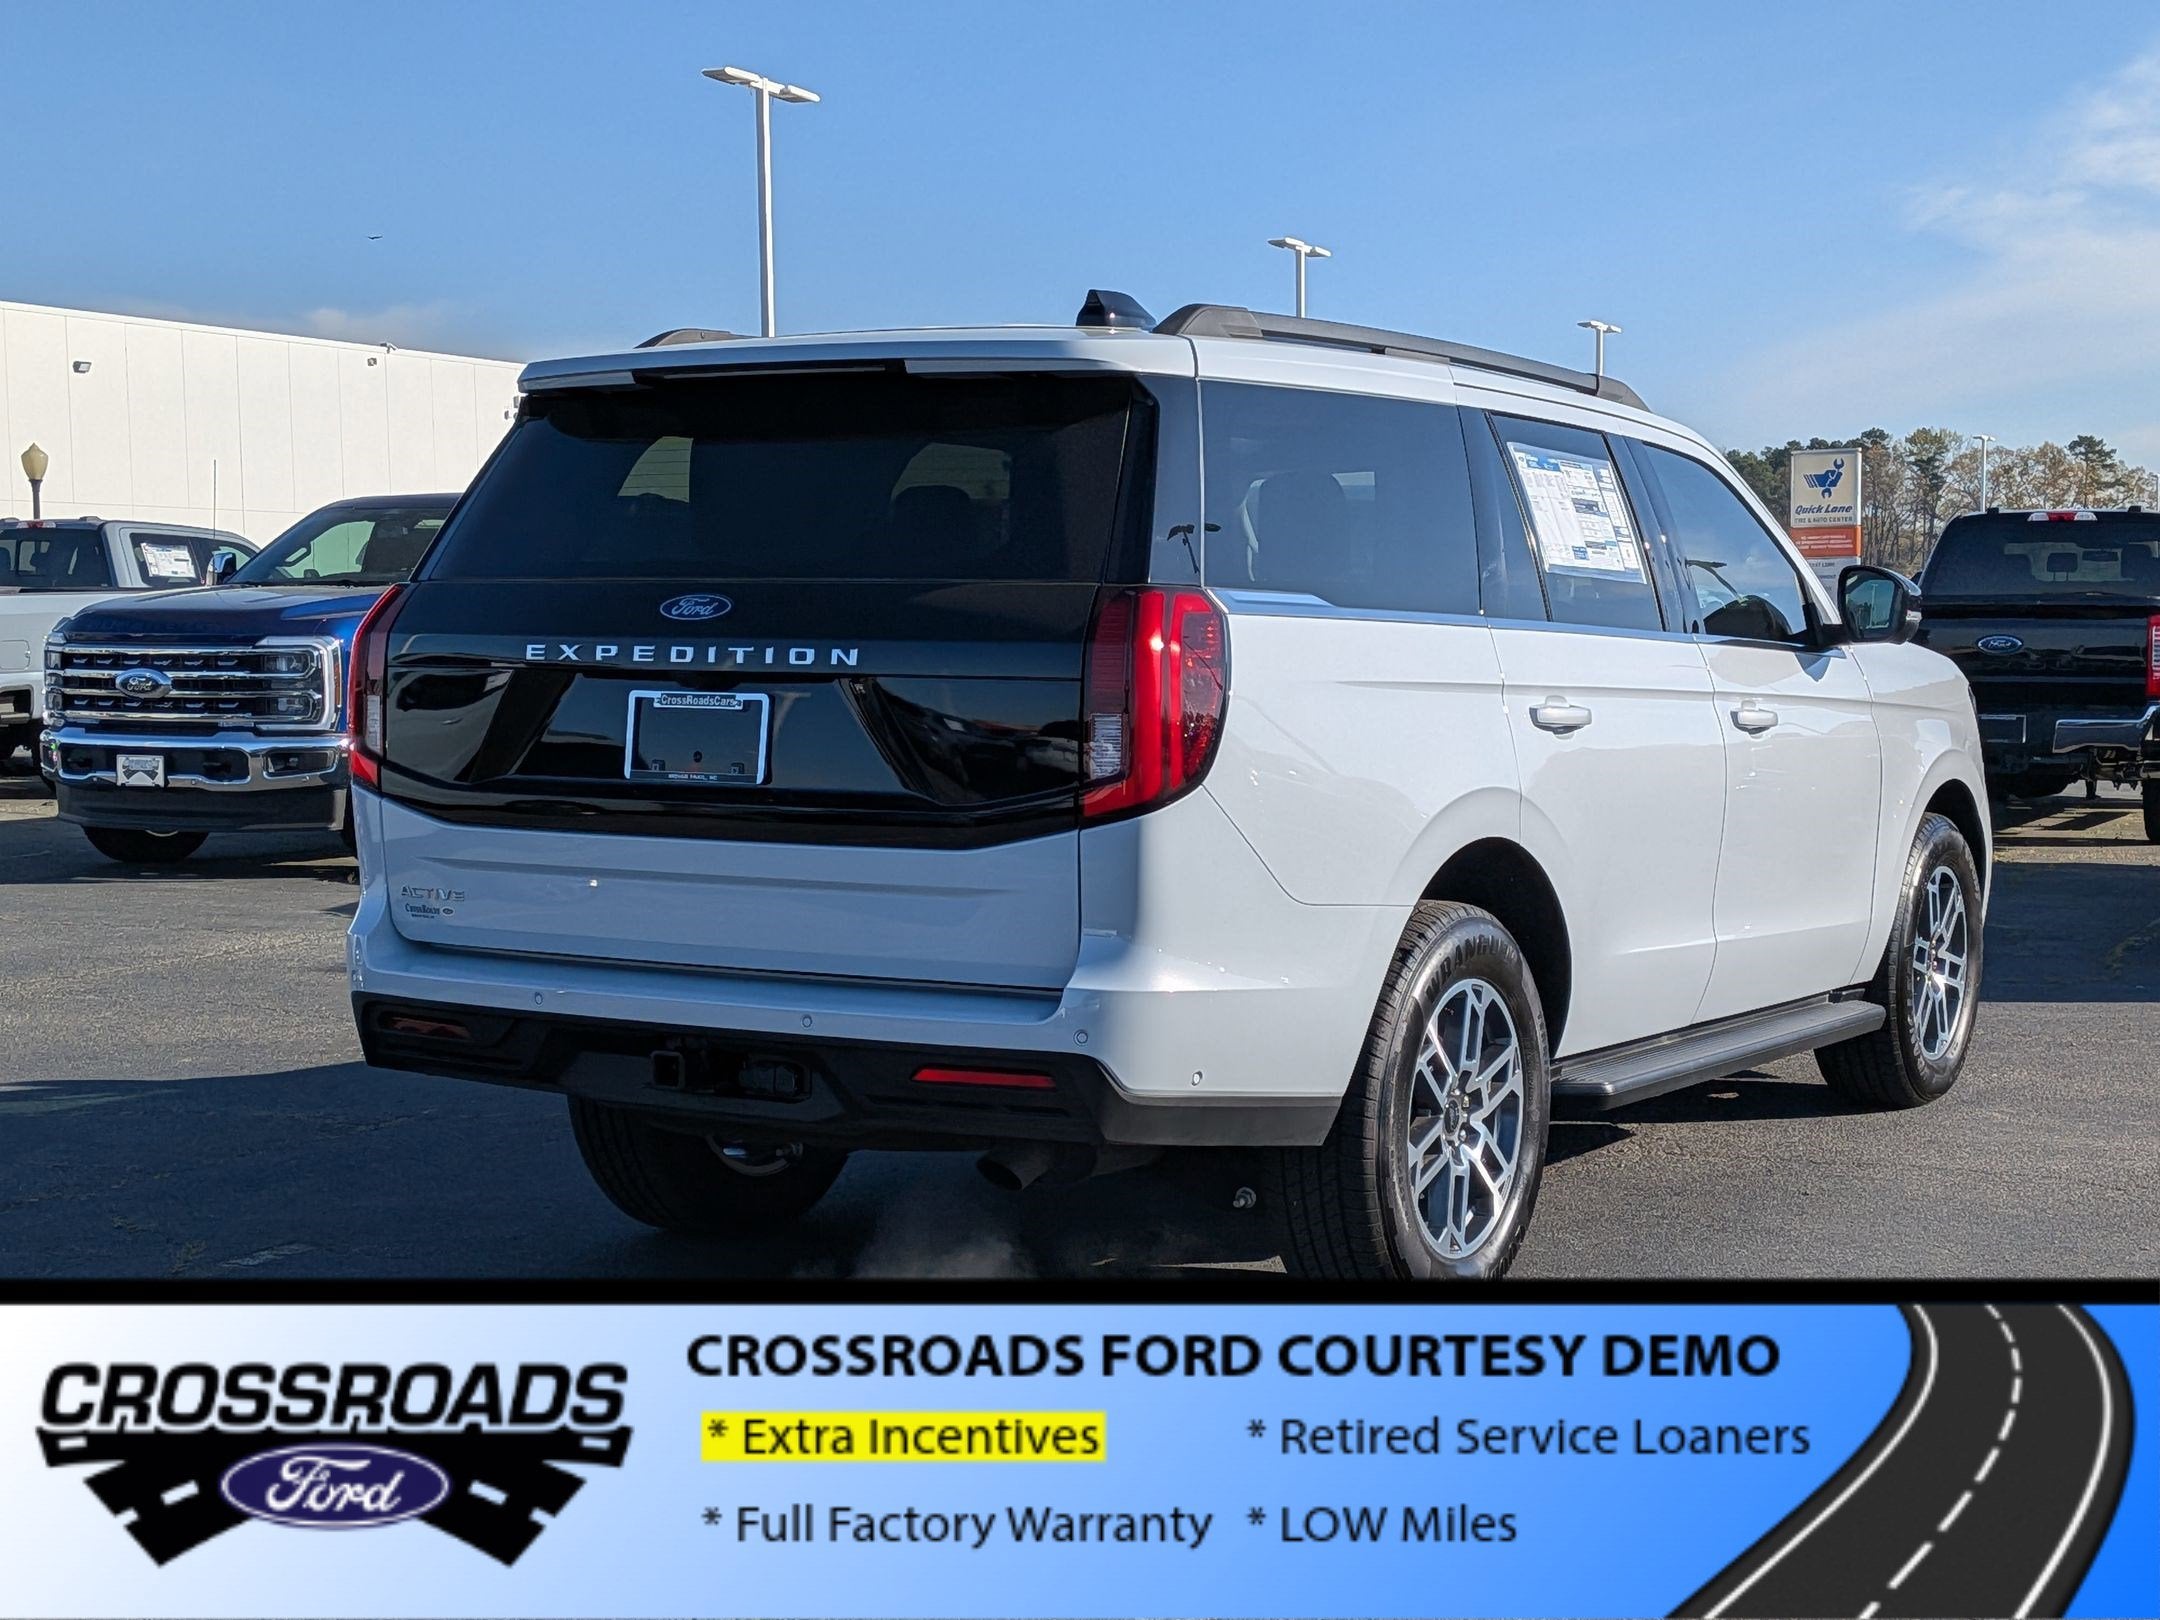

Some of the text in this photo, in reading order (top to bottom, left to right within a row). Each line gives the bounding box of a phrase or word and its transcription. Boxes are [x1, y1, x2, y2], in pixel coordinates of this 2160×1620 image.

[1795, 504, 1853, 515] Quick Lane
[672, 596, 714, 616] Ford
[525, 643, 859, 667] EXPEDITION
[401, 885, 465, 902] ACTIVE
